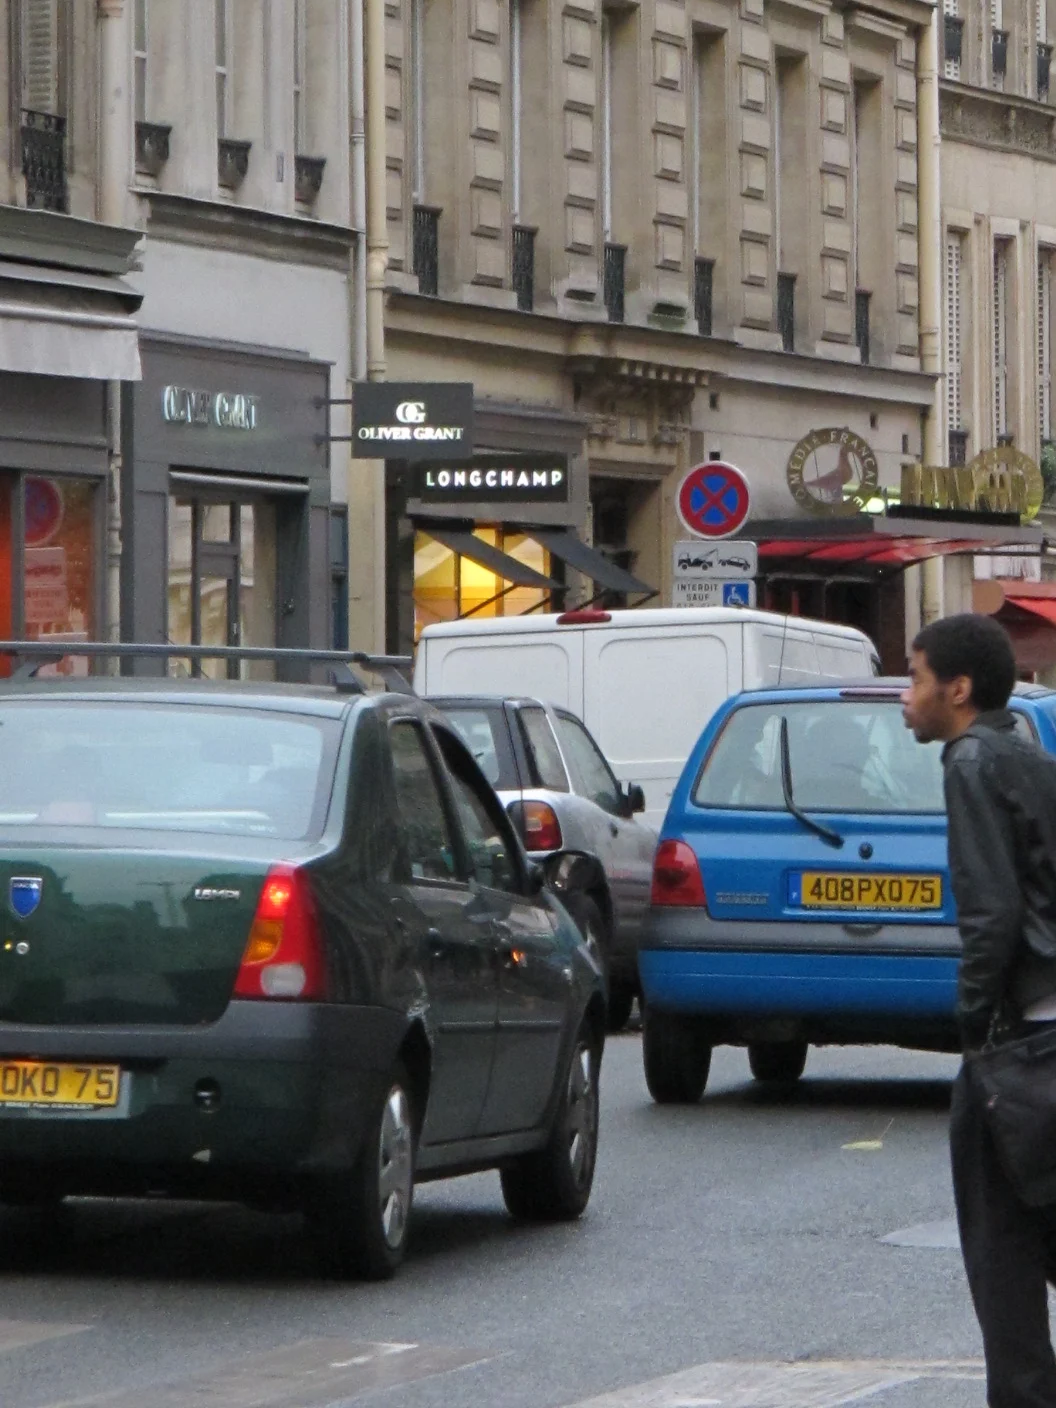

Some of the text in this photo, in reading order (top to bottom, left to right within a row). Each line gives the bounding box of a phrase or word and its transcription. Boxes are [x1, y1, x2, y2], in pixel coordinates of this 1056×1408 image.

[358, 427, 464, 441] OLIVER GRANT
[426, 470, 564, 488] LONGCHAMP
[677, 583, 719, 591] INTERDIT
[686, 593, 710, 602] SAUF
[73, 1067, 114, 1100] 75
